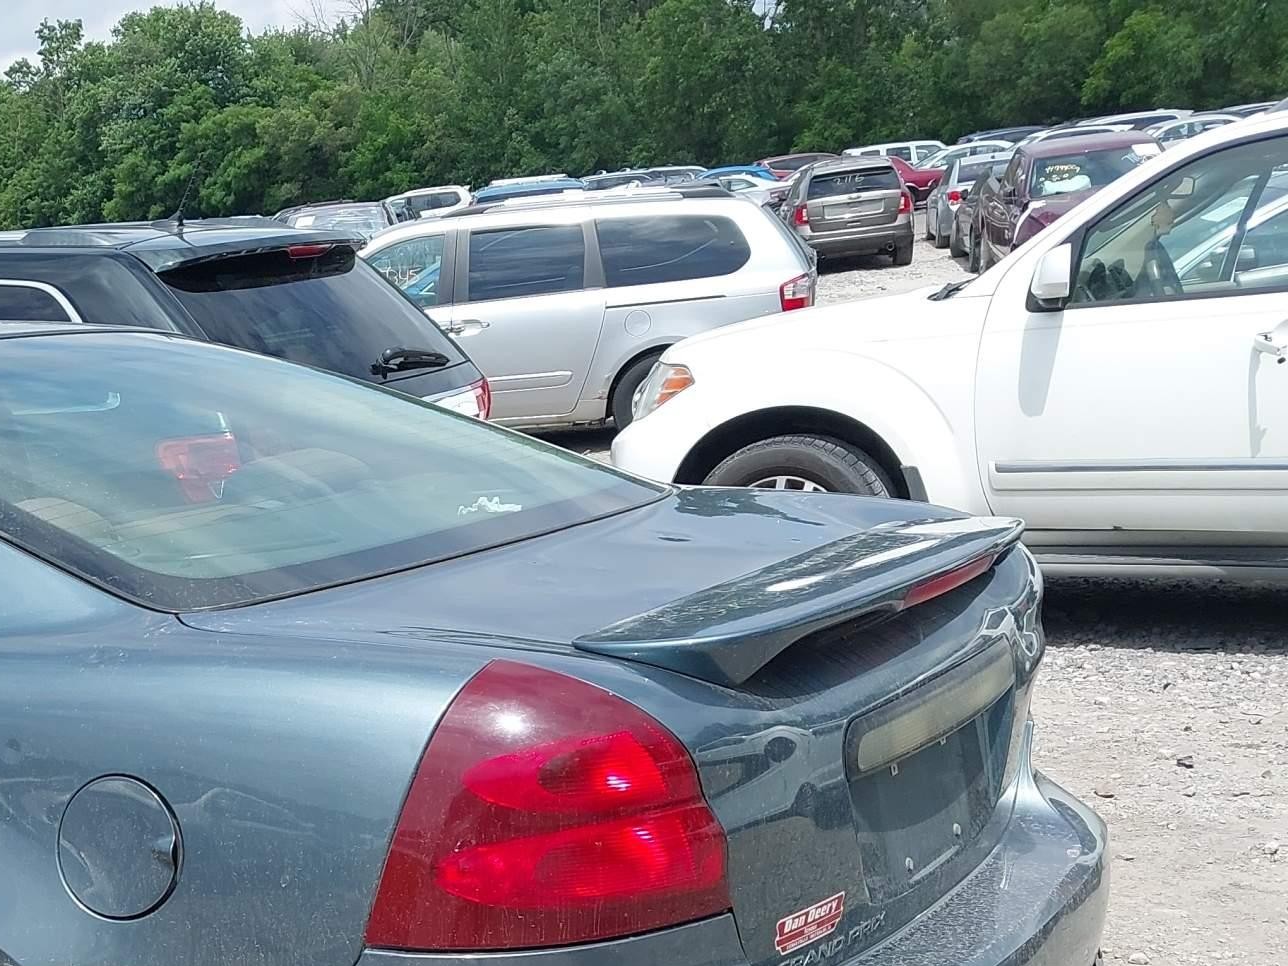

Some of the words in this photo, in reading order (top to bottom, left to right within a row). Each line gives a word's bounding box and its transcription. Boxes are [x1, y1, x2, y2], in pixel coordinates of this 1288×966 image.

[784, 914, 807, 934] Dan
[807, 899, 839, 924] Deery
[847, 910, 887, 946] PRIX
